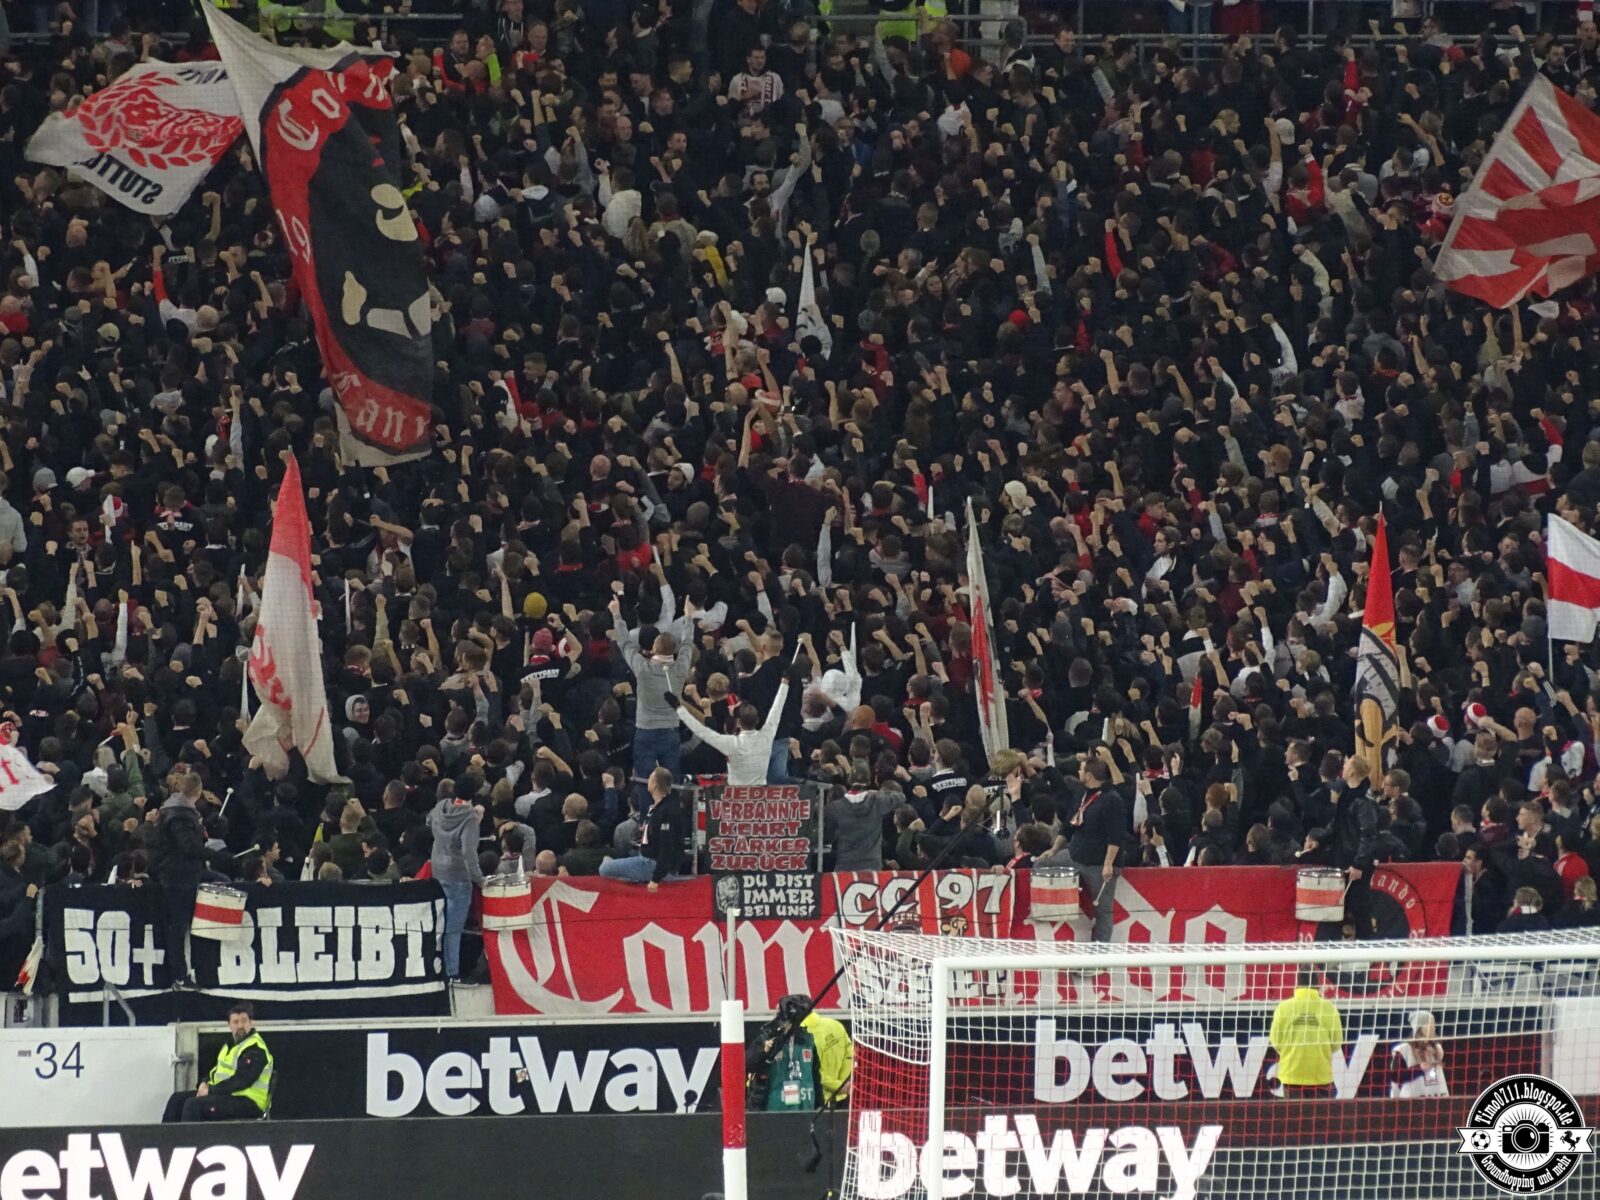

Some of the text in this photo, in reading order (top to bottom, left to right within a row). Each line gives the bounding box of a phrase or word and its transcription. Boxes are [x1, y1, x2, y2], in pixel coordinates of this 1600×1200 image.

[721, 785, 799, 801] JEDER
[709, 800, 811, 821] VERBANNTE
[719, 821, 802, 837] KEHRT
[743, 874, 815, 888] DU BIST
[743, 887, 815, 905] IMMER
[744, 904, 817, 918] BEI UNS!
[842, 873, 1013, 926] CC 97
[217, 898, 446, 986] BLEIBT!
[35, 1041, 85, 1080] 34
[366, 1032, 721, 1118] betway
[1034, 1019, 1380, 1103] betwy
[858, 1110, 1224, 1200] betway
